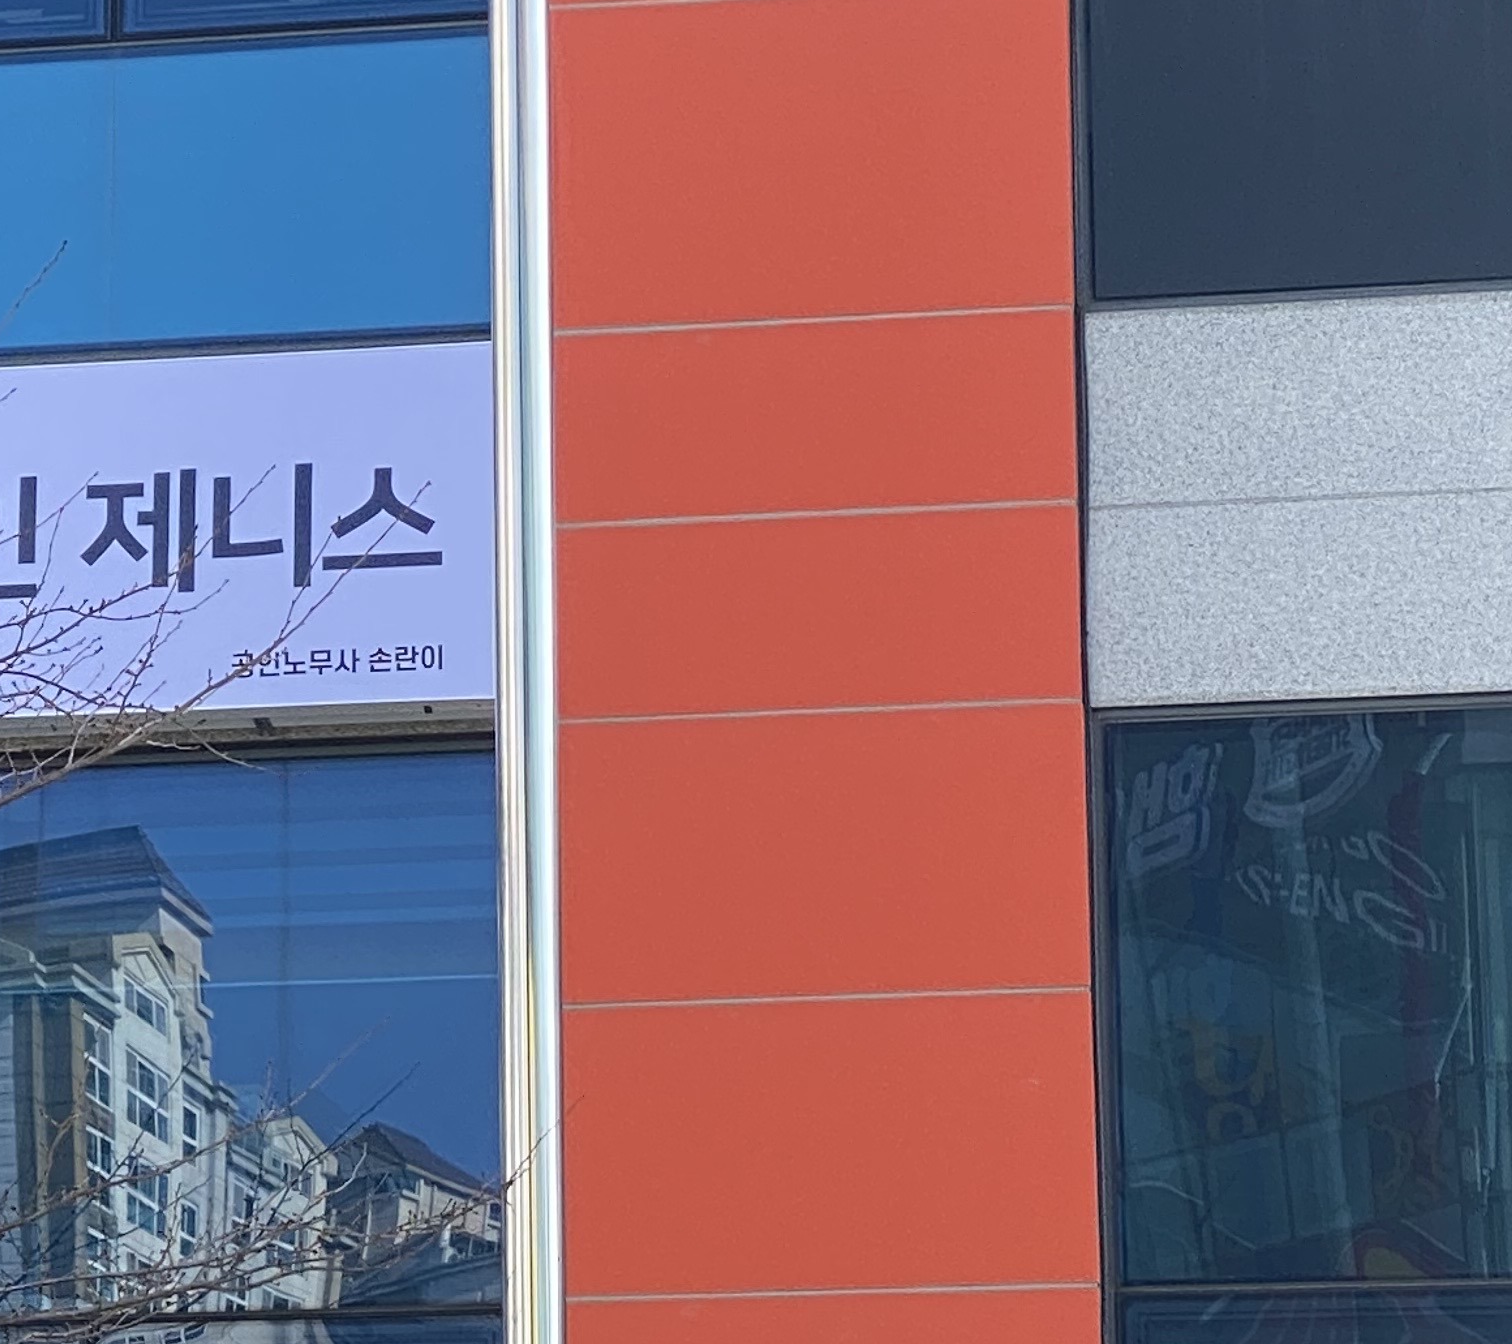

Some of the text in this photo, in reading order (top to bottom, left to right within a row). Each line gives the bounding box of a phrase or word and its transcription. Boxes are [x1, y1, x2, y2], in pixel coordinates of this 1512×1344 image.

[81, 461, 443, 594] 제니스
[231, 644, 444, 678] 공인노무사 손란이
